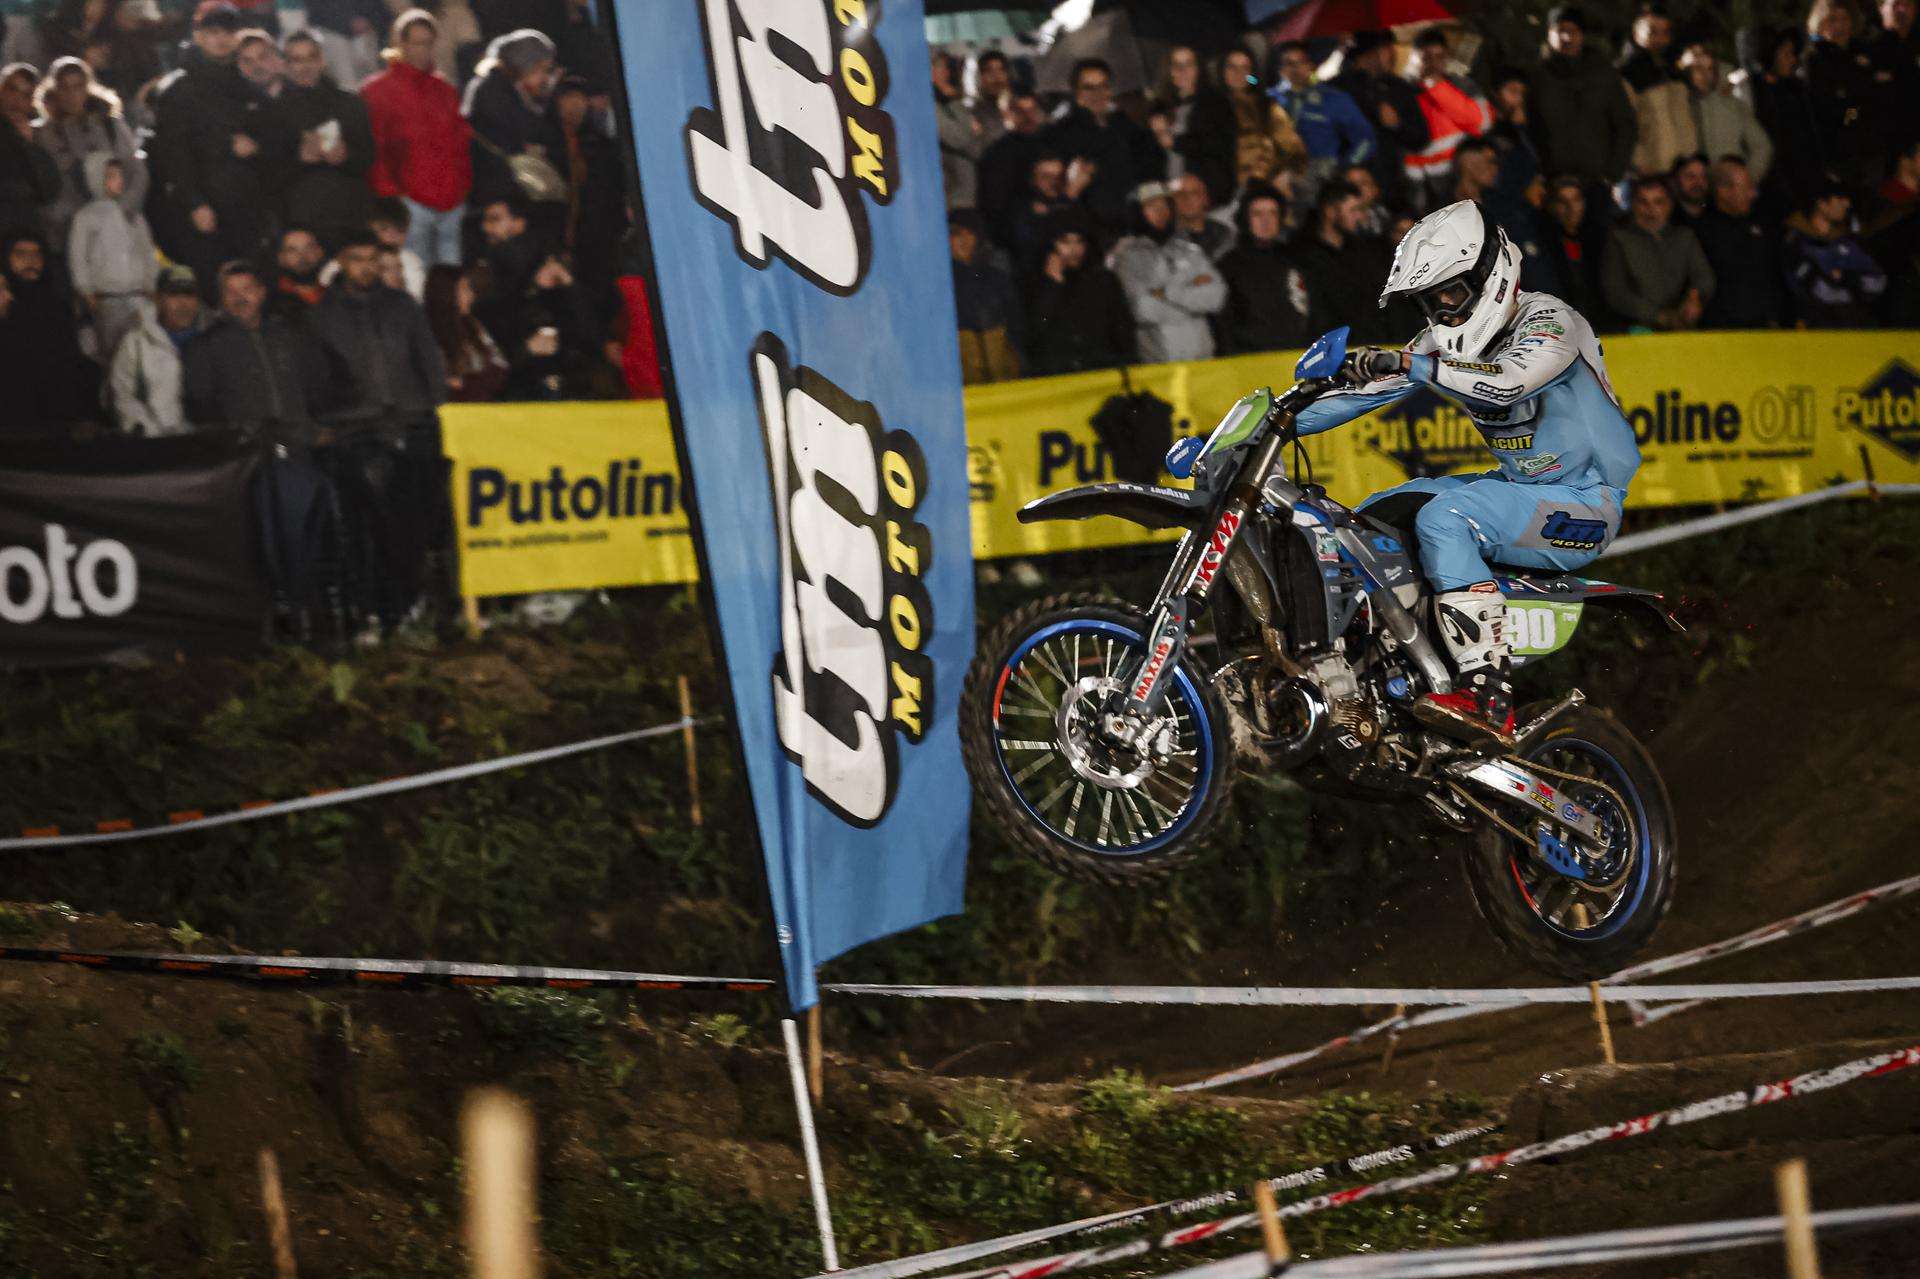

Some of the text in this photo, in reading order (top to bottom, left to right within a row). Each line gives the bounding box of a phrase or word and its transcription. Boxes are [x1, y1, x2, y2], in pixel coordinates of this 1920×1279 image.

[1751, 384, 1816, 442] Oil
[468, 459, 682, 527] Putolin
[1197, 510, 1240, 586] KYB
[882, 450, 921, 735] MOTO
